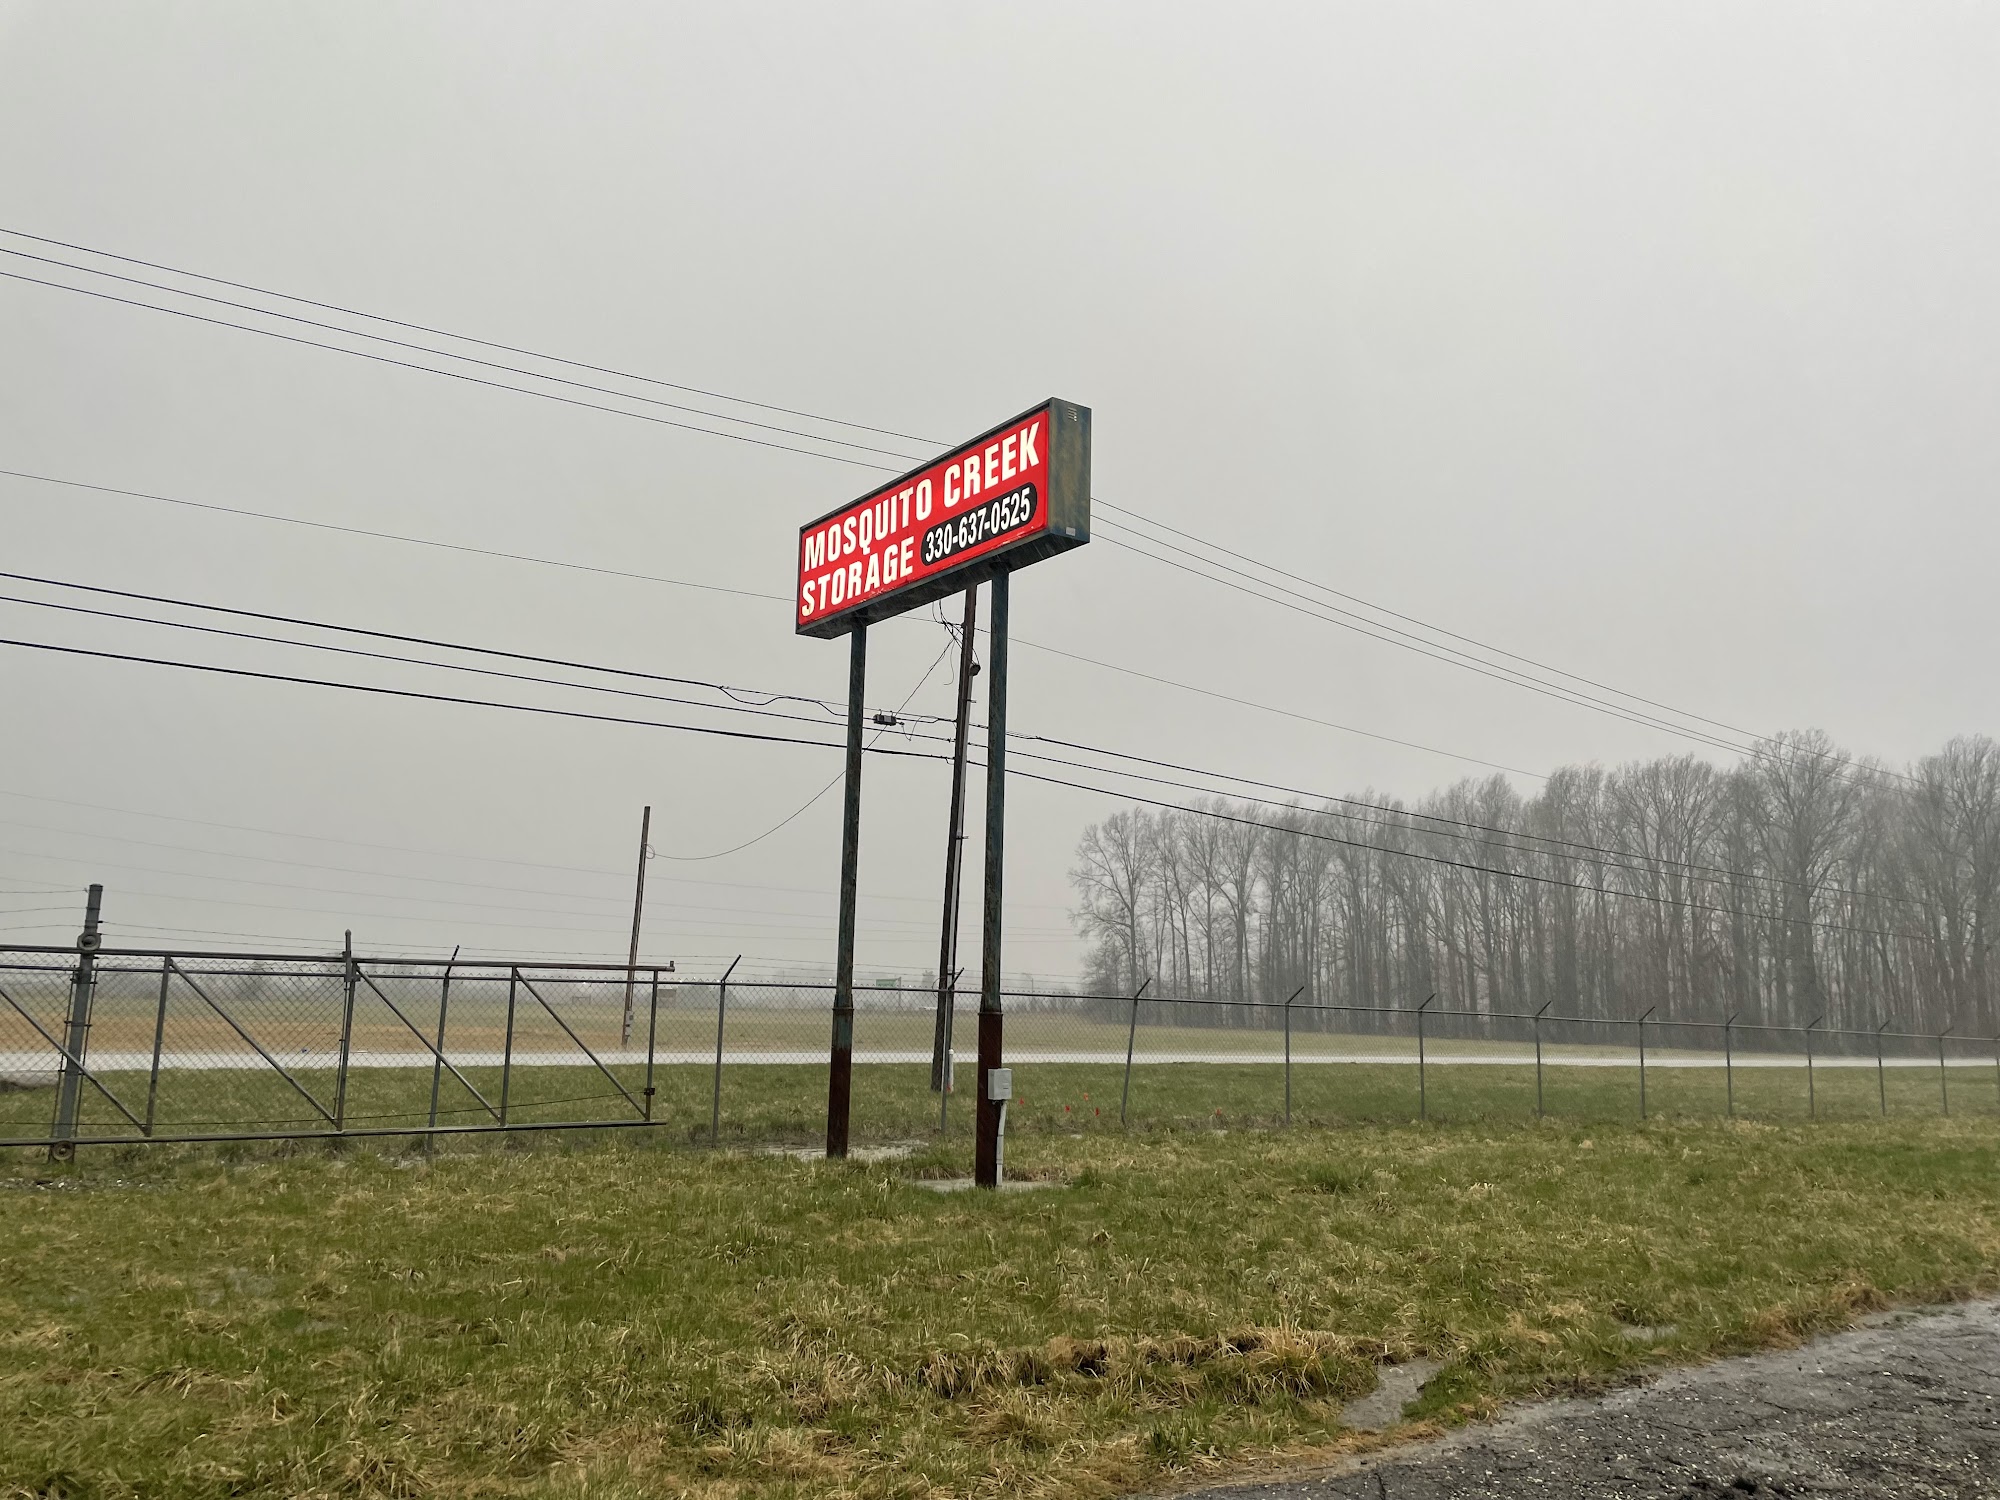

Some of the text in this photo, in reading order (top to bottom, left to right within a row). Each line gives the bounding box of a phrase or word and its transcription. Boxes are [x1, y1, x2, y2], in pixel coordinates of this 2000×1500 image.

[804, 421, 1040, 572] MOSQUITO CREEK
[925, 487, 1031, 562] 330-637-0525
[801, 535, 915, 616] STORAGE
